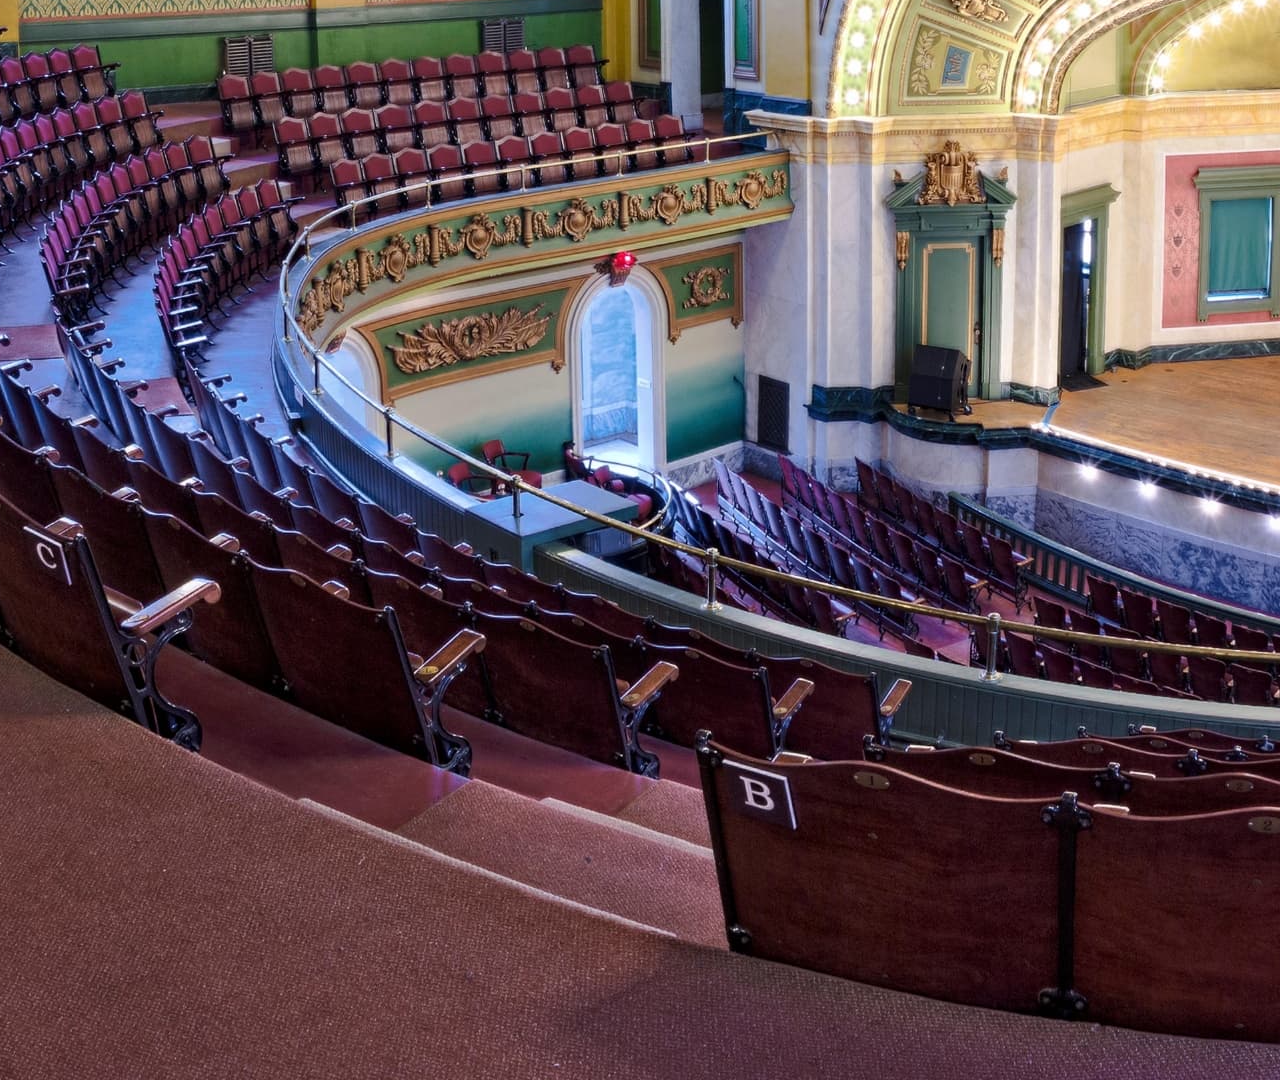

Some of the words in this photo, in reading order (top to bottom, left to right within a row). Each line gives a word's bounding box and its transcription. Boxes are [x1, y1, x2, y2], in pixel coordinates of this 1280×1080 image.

[36, 542, 57, 569] C
[869, 775, 874, 786] 1
[739, 775, 776, 812] B
[1263, 820, 1273, 831] 2
